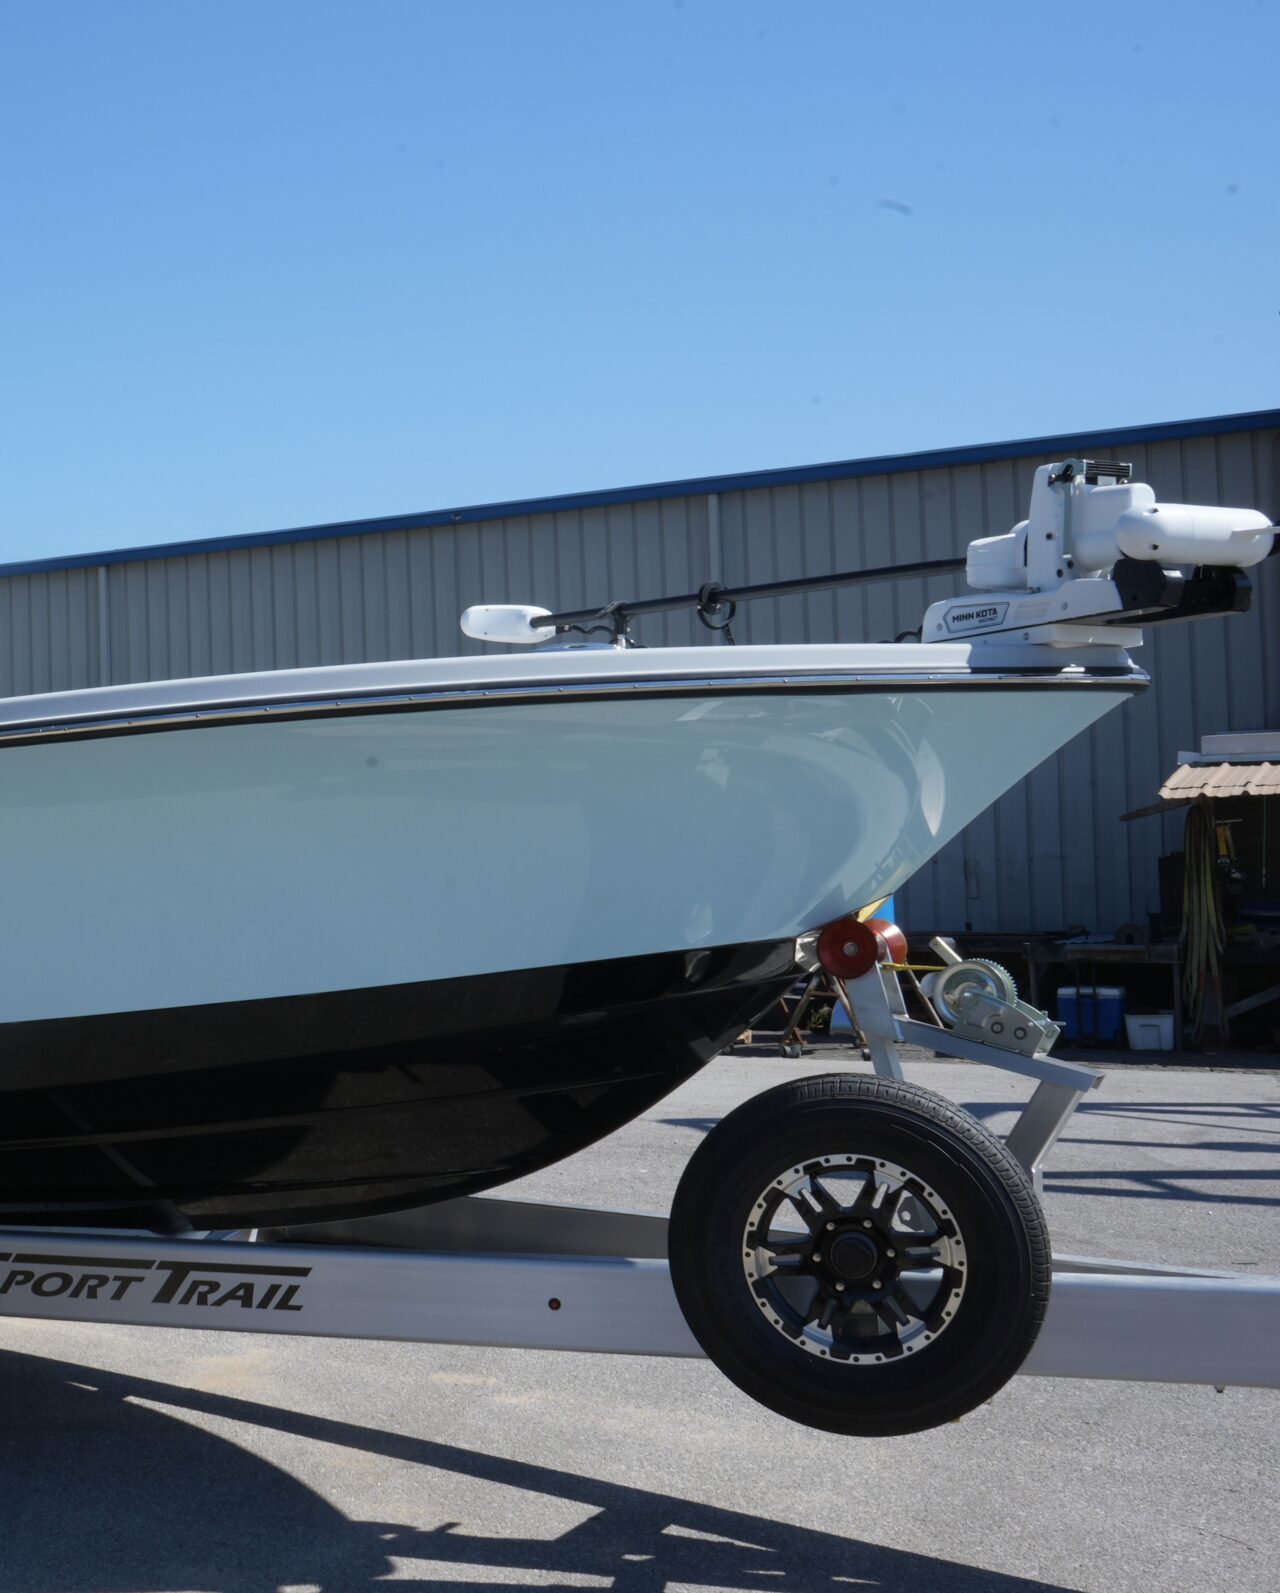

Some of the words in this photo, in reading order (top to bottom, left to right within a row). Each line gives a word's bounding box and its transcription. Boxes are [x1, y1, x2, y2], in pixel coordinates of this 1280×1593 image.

[952, 612, 975, 623] MINN
[975, 608, 998, 619] KOTA
[151, 1260, 313, 1312] TRAIL
